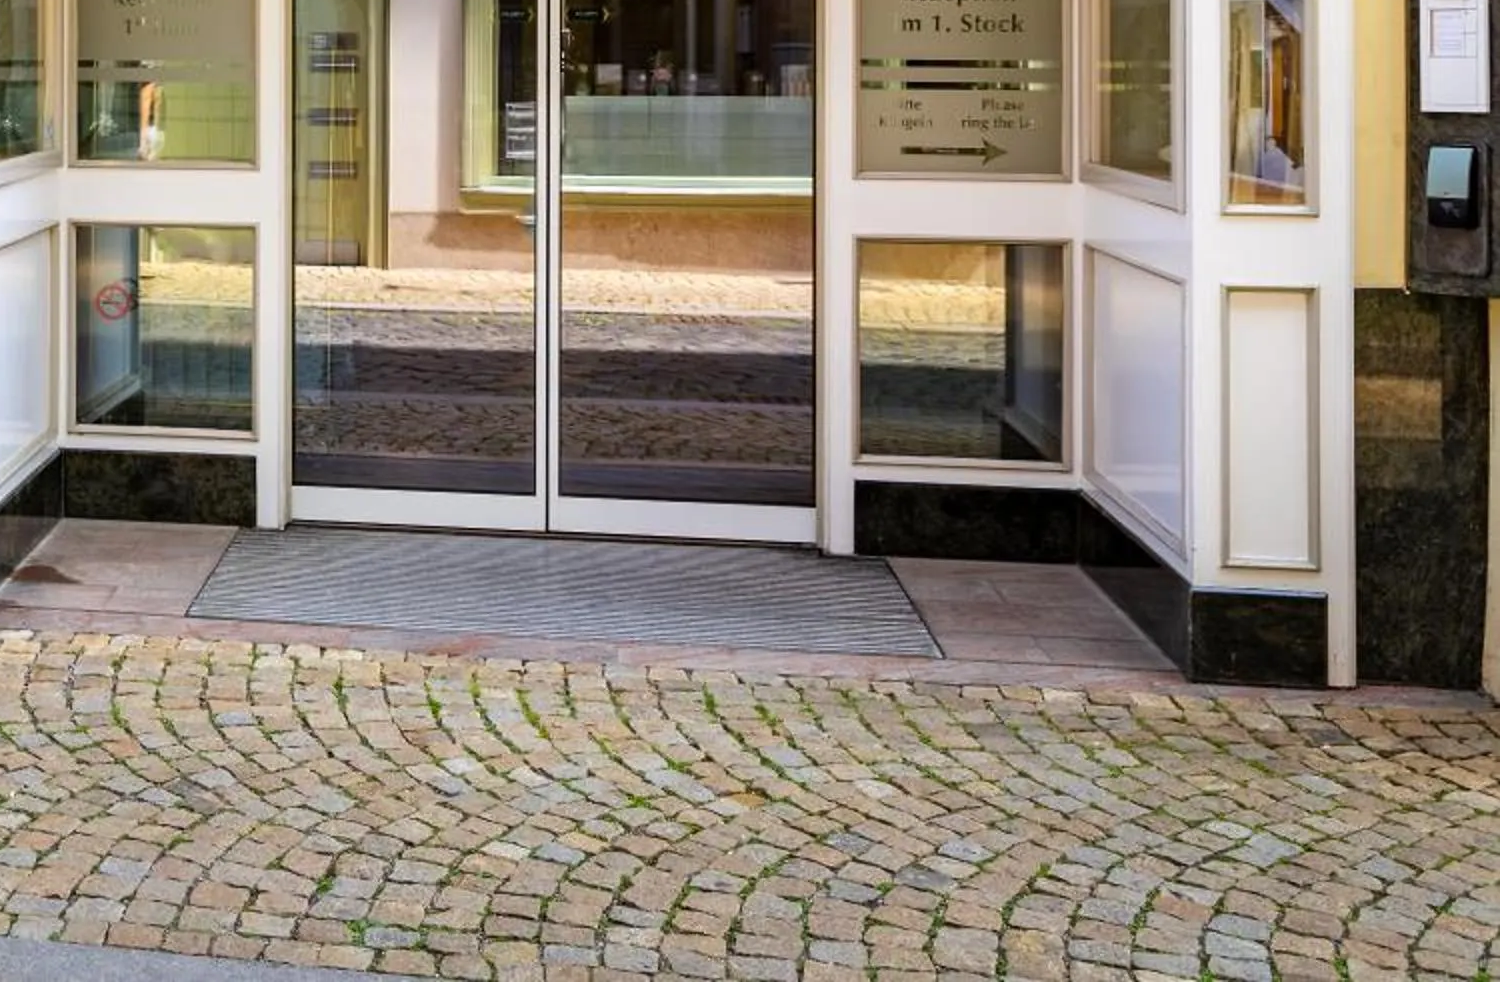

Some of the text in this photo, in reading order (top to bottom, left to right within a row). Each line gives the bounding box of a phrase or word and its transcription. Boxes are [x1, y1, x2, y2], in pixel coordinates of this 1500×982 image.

[931, 14, 951, 33] 1.
[961, 13, 1026, 33] Stock
[961, 115, 989, 130] ring
